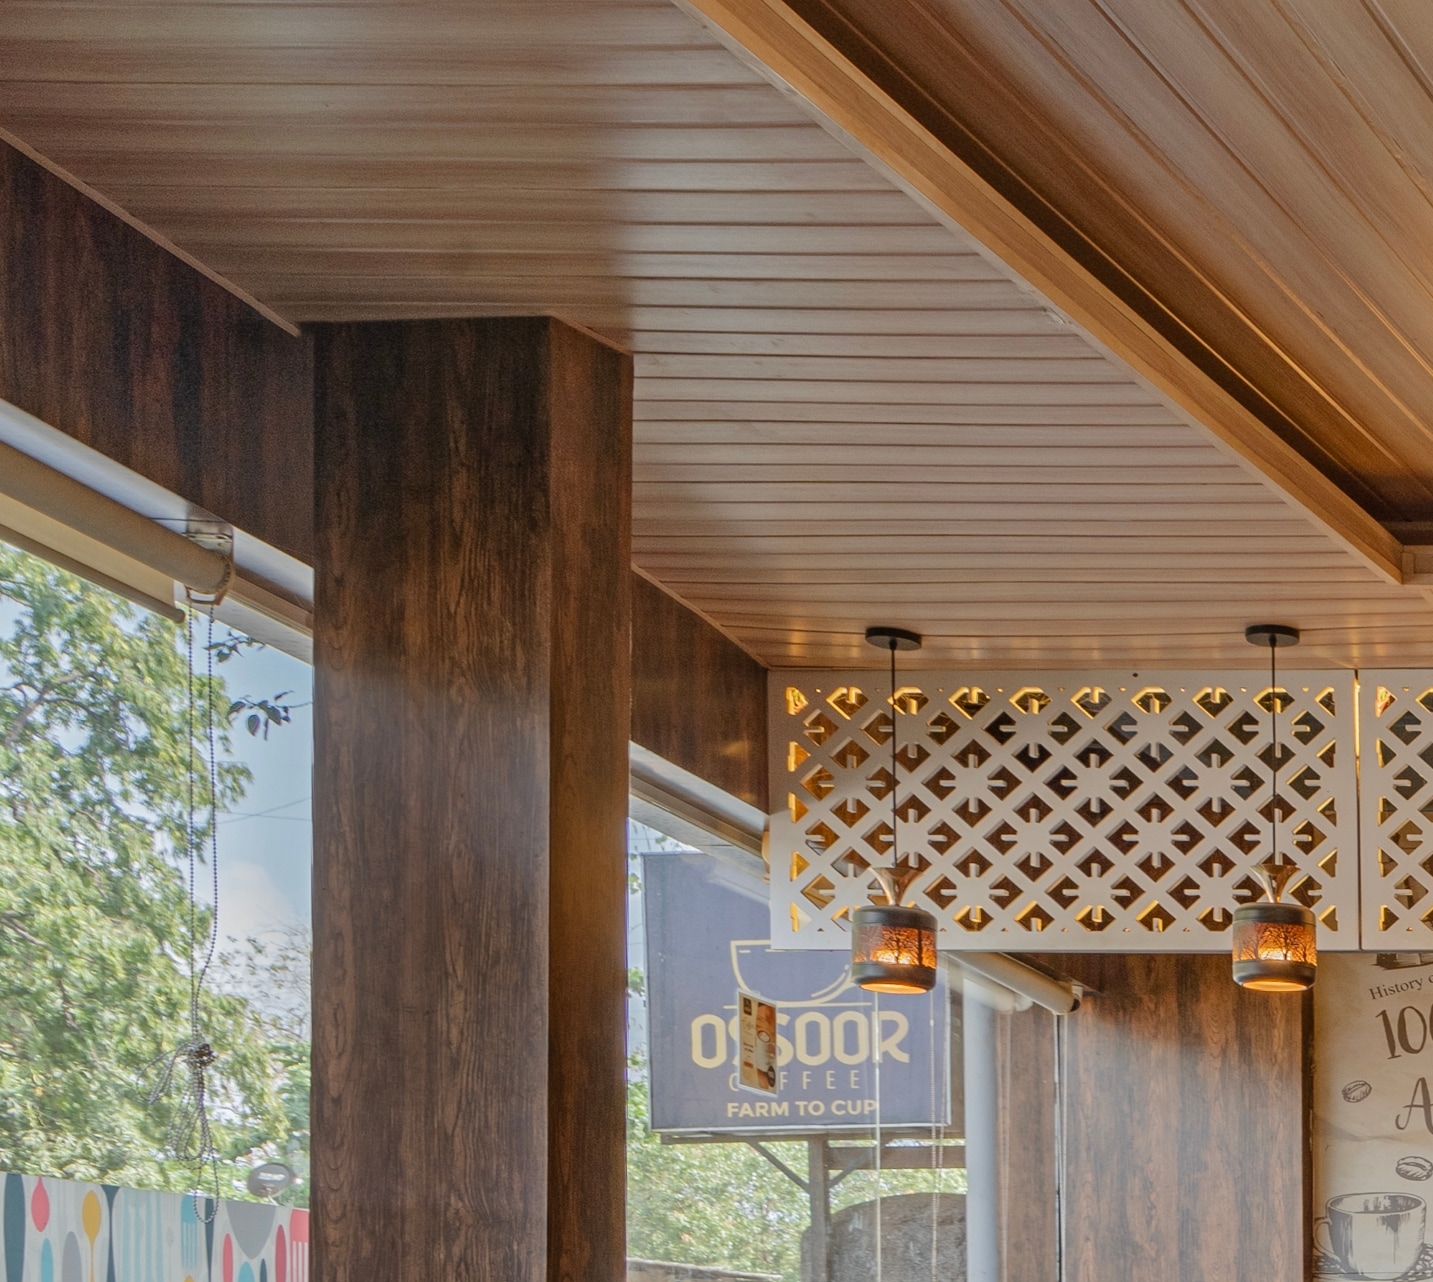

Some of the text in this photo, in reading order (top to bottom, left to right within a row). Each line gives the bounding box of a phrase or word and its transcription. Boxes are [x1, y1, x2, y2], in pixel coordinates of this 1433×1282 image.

[1368, 976, 1425, 1000] History
[728, 1070, 860, 1092] CFFEE
[727, 1100, 877, 1118] FARM TO CUP
